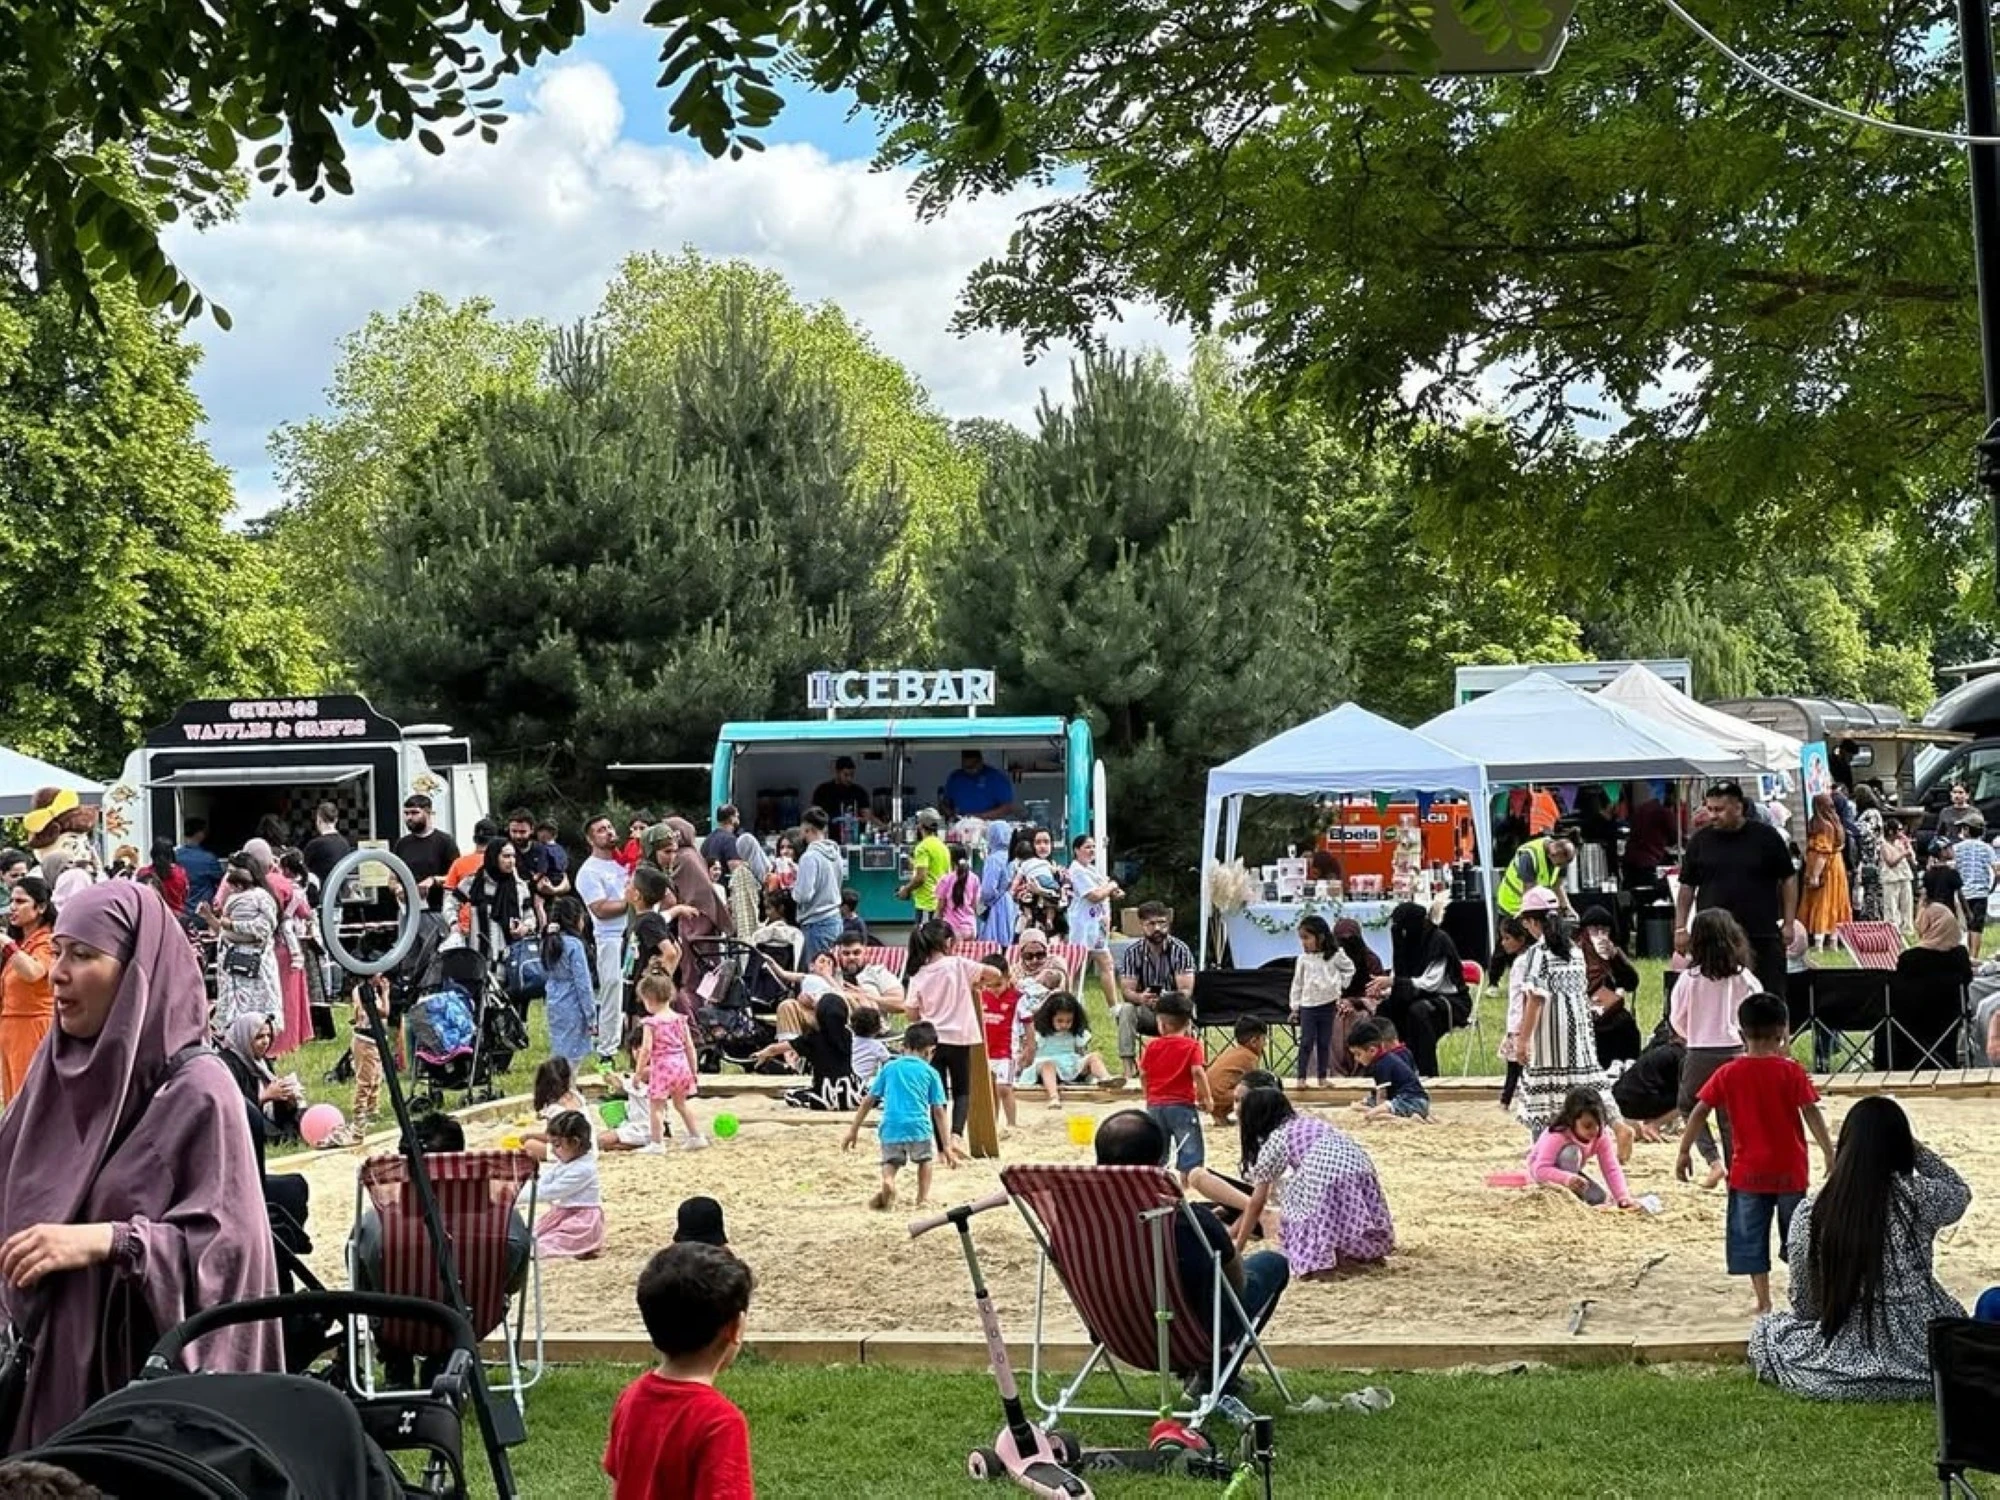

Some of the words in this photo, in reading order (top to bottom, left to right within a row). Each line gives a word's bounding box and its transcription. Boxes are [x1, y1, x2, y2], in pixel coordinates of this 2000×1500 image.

[811, 669, 989, 707] ICEBAR
[228, 699, 318, 719] CHURROS
[183, 721, 273, 740] WAFFLES
[274, 720, 292, 739] &
[294, 719, 367, 738] CREPES
